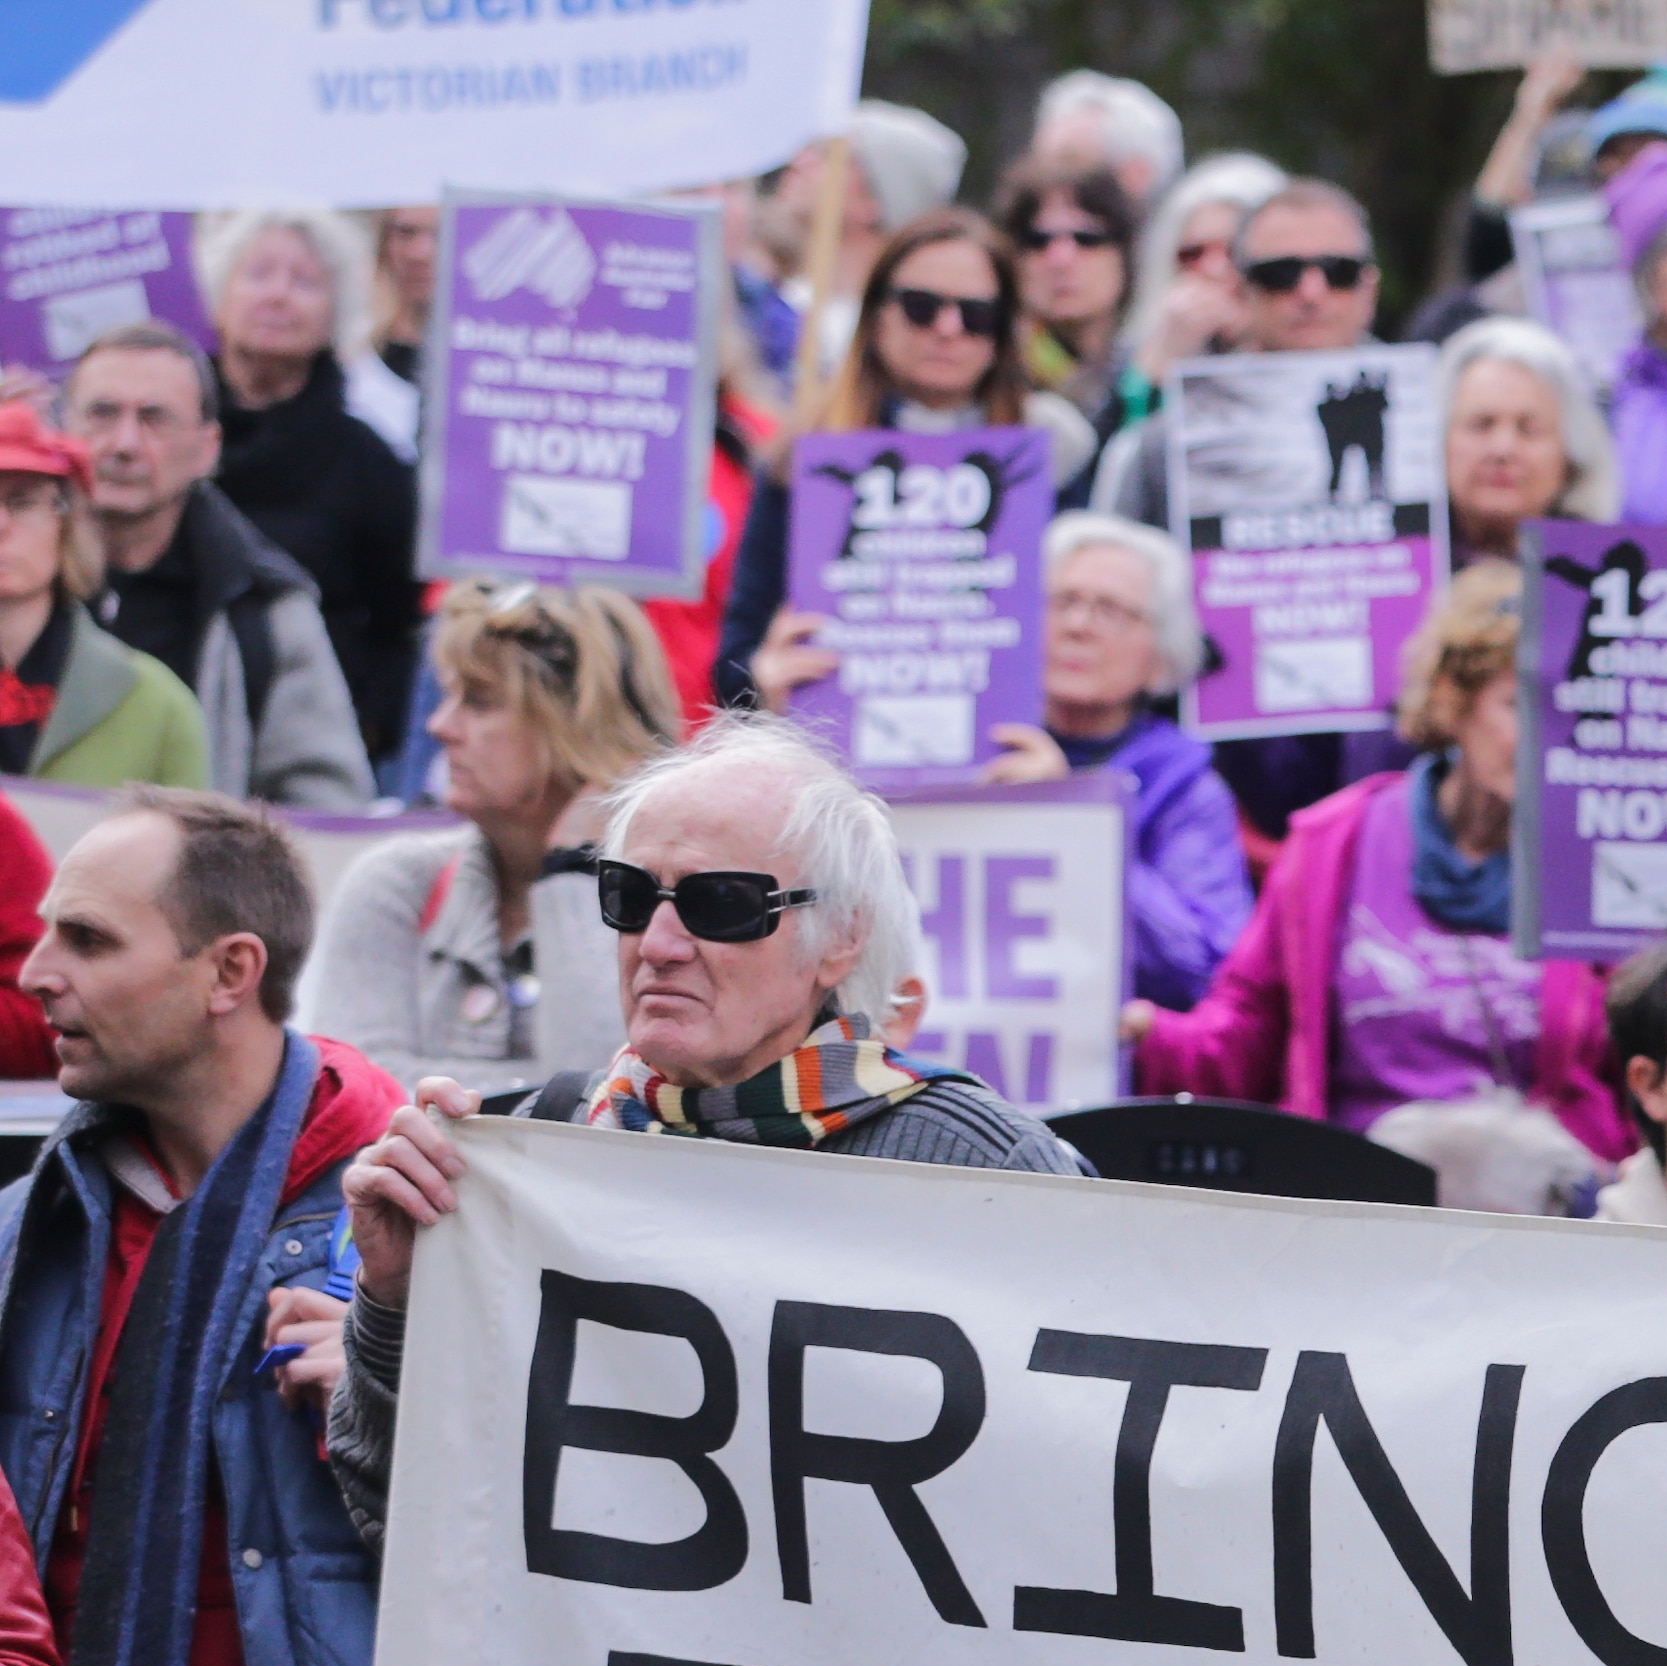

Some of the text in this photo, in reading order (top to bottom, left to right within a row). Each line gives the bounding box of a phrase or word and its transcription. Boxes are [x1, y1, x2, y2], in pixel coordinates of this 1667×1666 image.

[315, 42, 750, 114] VICTORIAN BRANCH
[490, 420, 647, 481] NOW!
[852, 463, 992, 528] 120
[1222, 501, 1397, 550] RESCUE
[839, 650, 993, 696] NOW!
[1553, 676, 1627, 713] still
[1572, 716, 1625, 750] on
